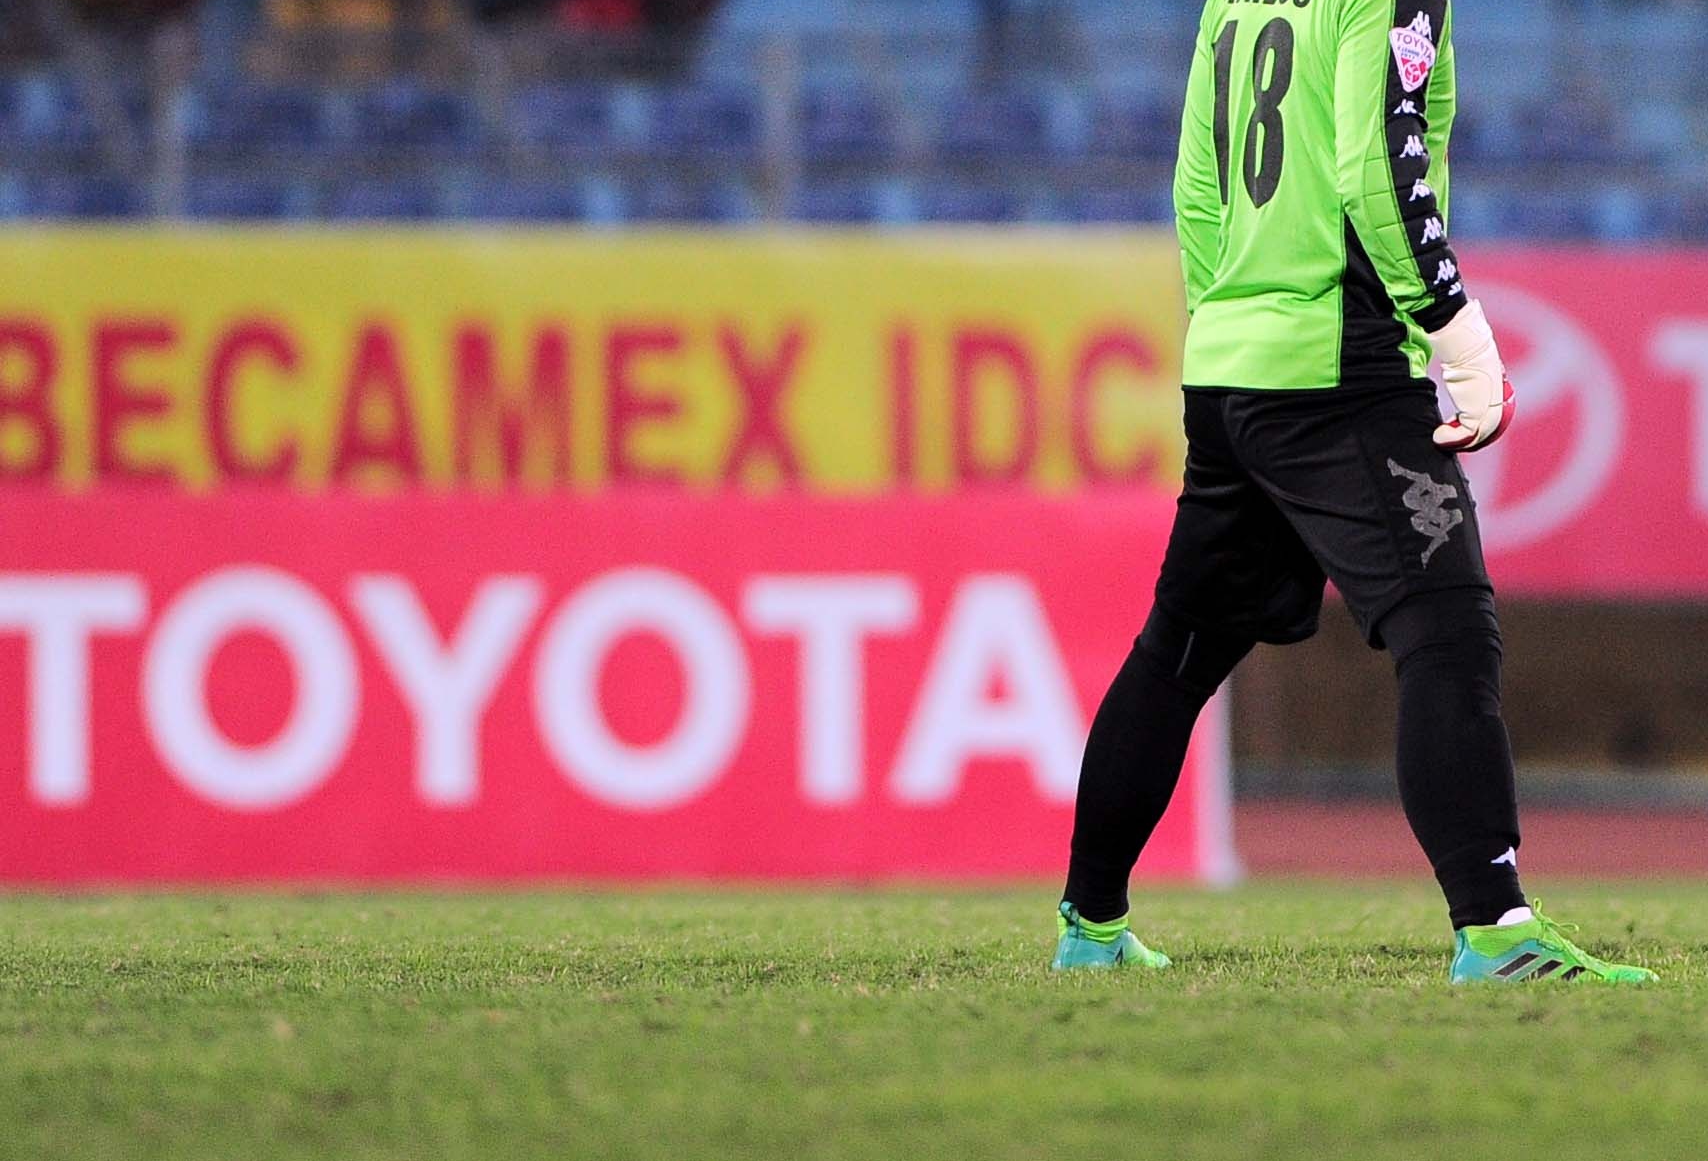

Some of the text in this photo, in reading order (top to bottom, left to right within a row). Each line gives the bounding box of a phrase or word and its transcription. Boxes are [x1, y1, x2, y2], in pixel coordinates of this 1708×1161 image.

[1212, 17, 1295, 209] 18
[0, 316, 1162, 489] BECAMEX IDC
[0, 565, 1090, 811] TOYOTA
